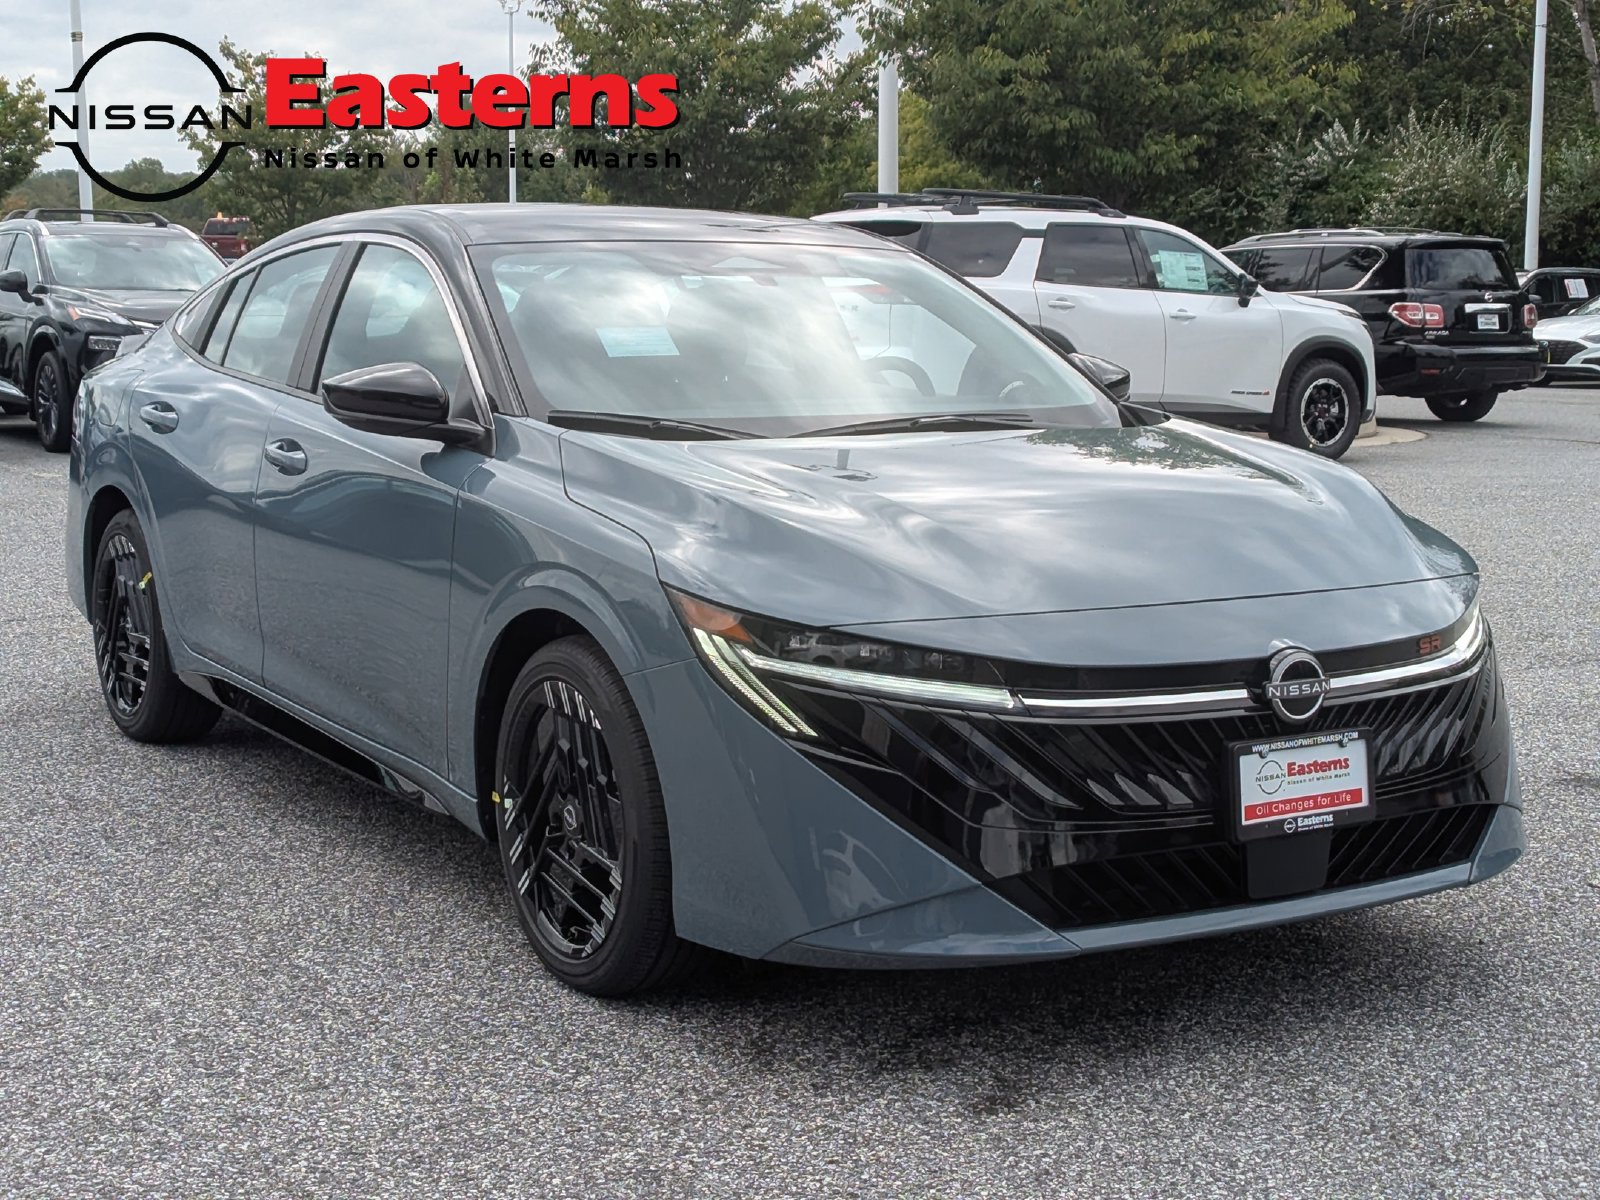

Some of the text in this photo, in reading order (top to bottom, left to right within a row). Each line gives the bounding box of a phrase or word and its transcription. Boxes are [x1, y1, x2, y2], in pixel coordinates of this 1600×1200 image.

[1268, 678, 1331, 697] NISSAN
[1251, 731, 1359, 754] WWW.NISSANOFWHITEMARSH.COM
[1286, 757, 1350, 777] Easterns
[1255, 772, 1287, 783] NISSAN
[1256, 792, 1352, 815] Oil Changes for Life
[1297, 814, 1334, 827] Easterns
